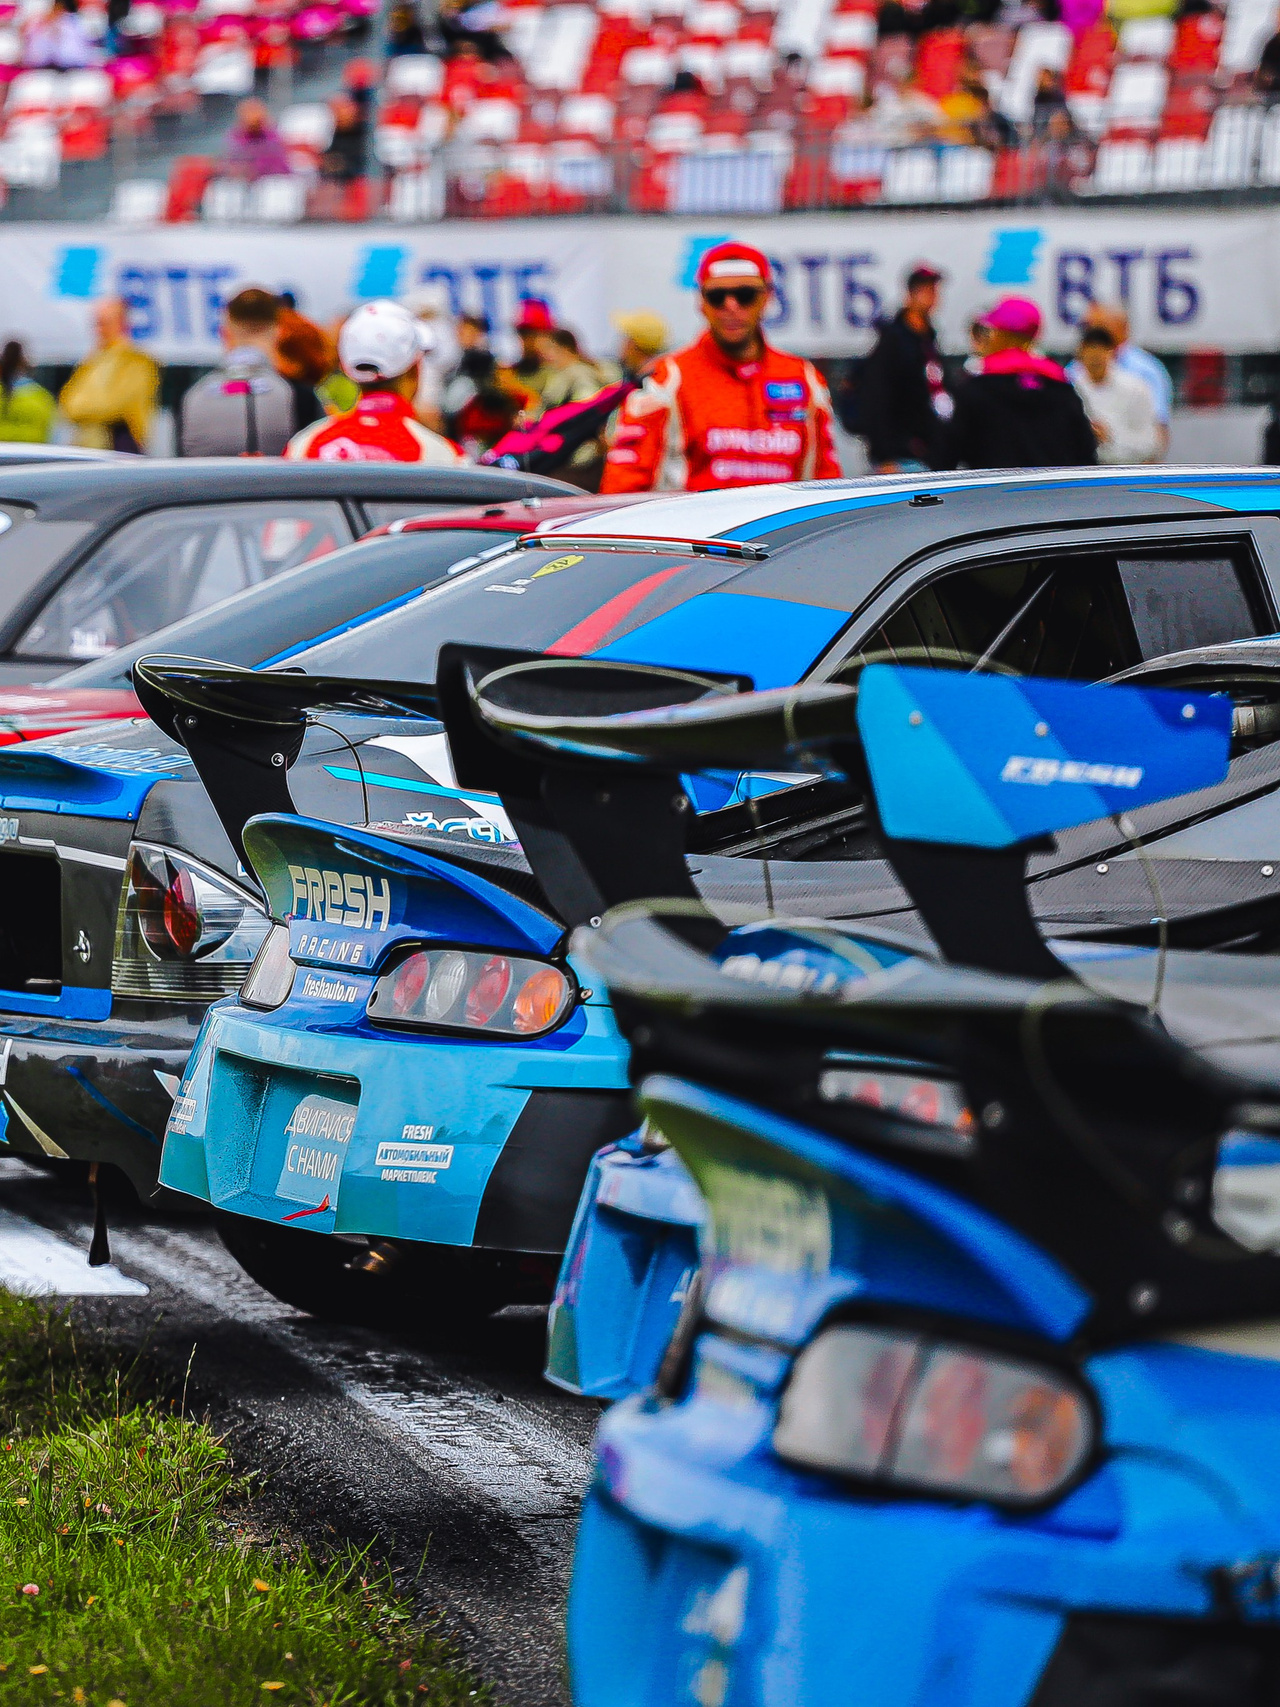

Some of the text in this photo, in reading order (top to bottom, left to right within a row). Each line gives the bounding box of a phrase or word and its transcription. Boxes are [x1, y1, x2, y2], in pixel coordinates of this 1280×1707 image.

[1056, 246, 1201, 326] ВТБ
[297, 934, 364, 964] RACING
[302, 973, 359, 1003] freshauto.ru
[401, 1124, 434, 1141] FRESH
